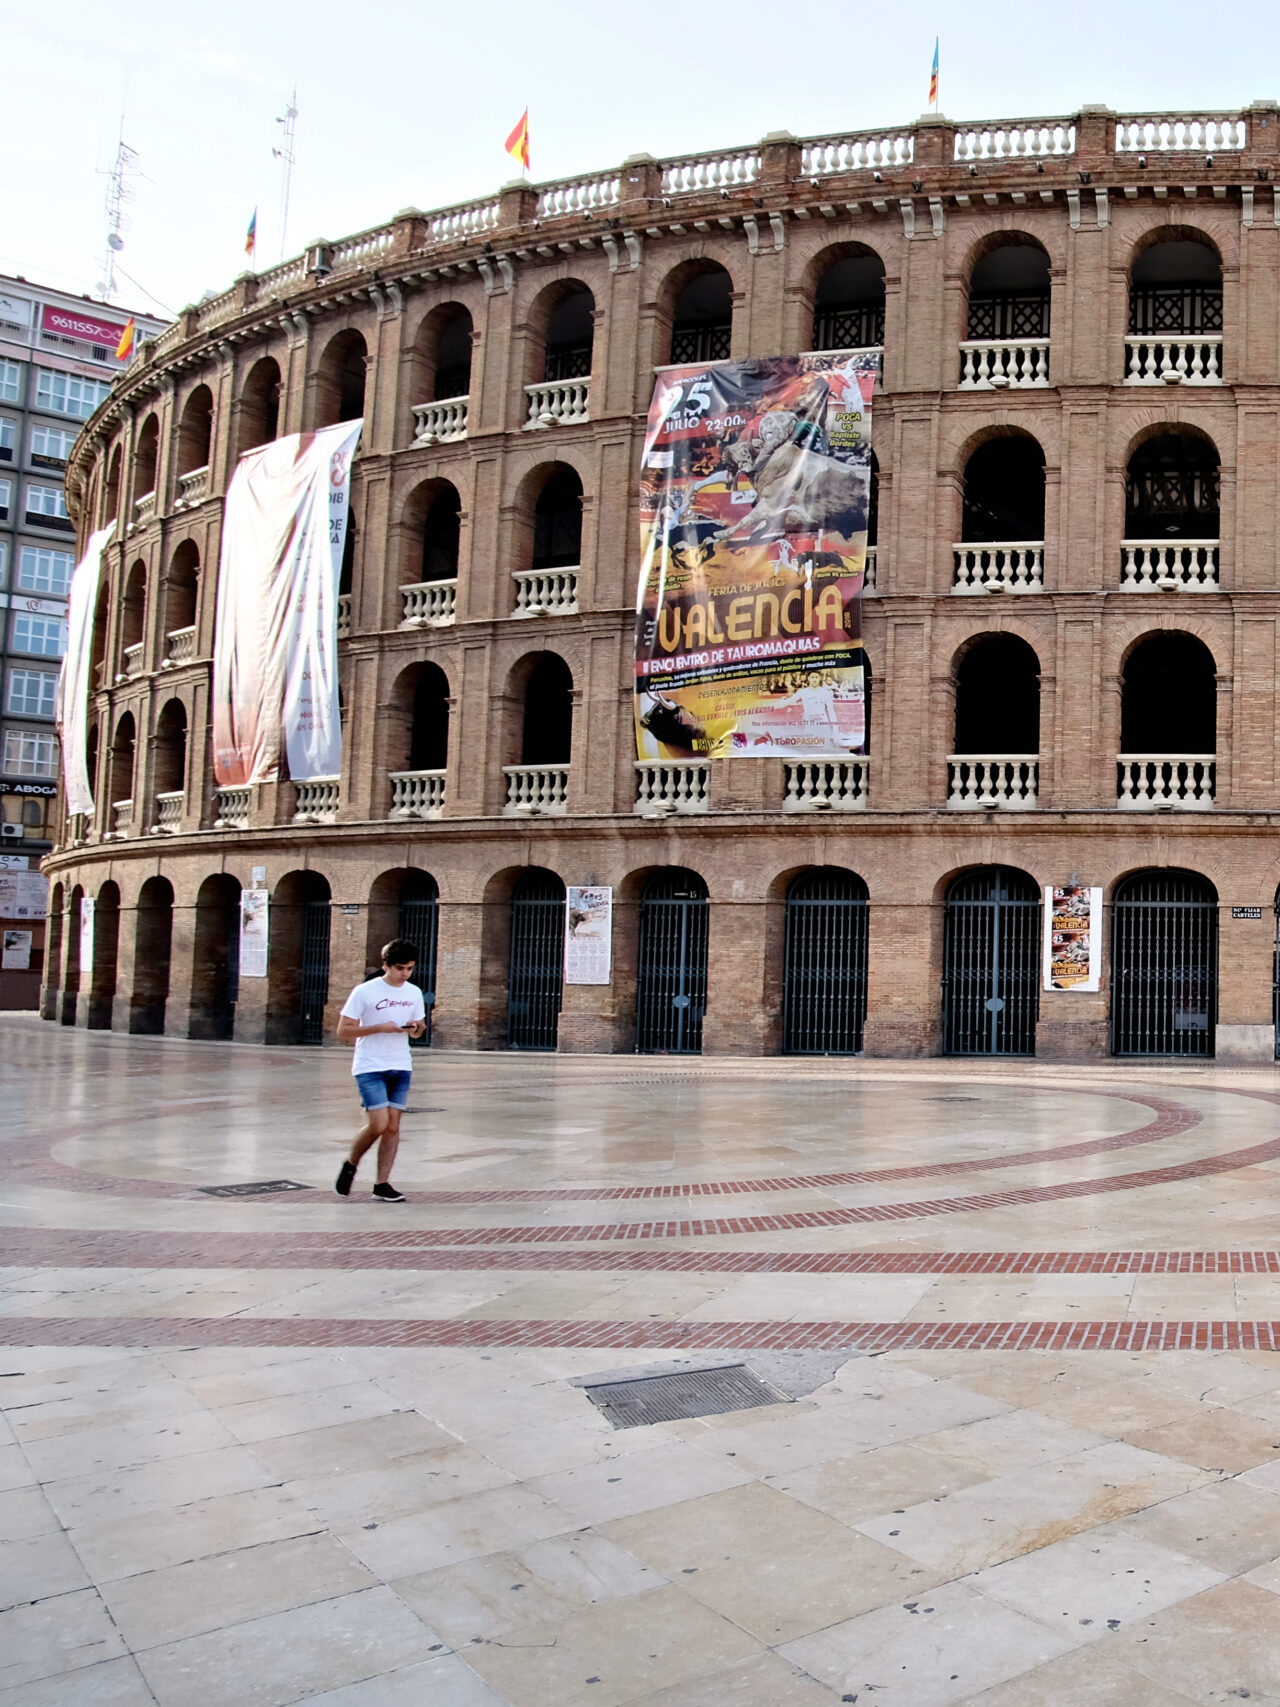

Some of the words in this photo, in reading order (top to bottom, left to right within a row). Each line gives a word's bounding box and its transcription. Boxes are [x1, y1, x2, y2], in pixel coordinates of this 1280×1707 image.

[659, 382, 712, 419] 25
[663, 417, 700, 434] JULIO
[836, 412, 861, 421] POCA
[709, 586, 737, 596] FERIA
[740, 583, 753, 592] DE
[754, 578, 785, 591] JULIO
[659, 585, 843, 652] VALENCIA
[651, 652, 708, 673] ENCUENTRO
[711, 650, 724, 661] DE
[727, 637, 820, 659] TAUROMAQUIAS
